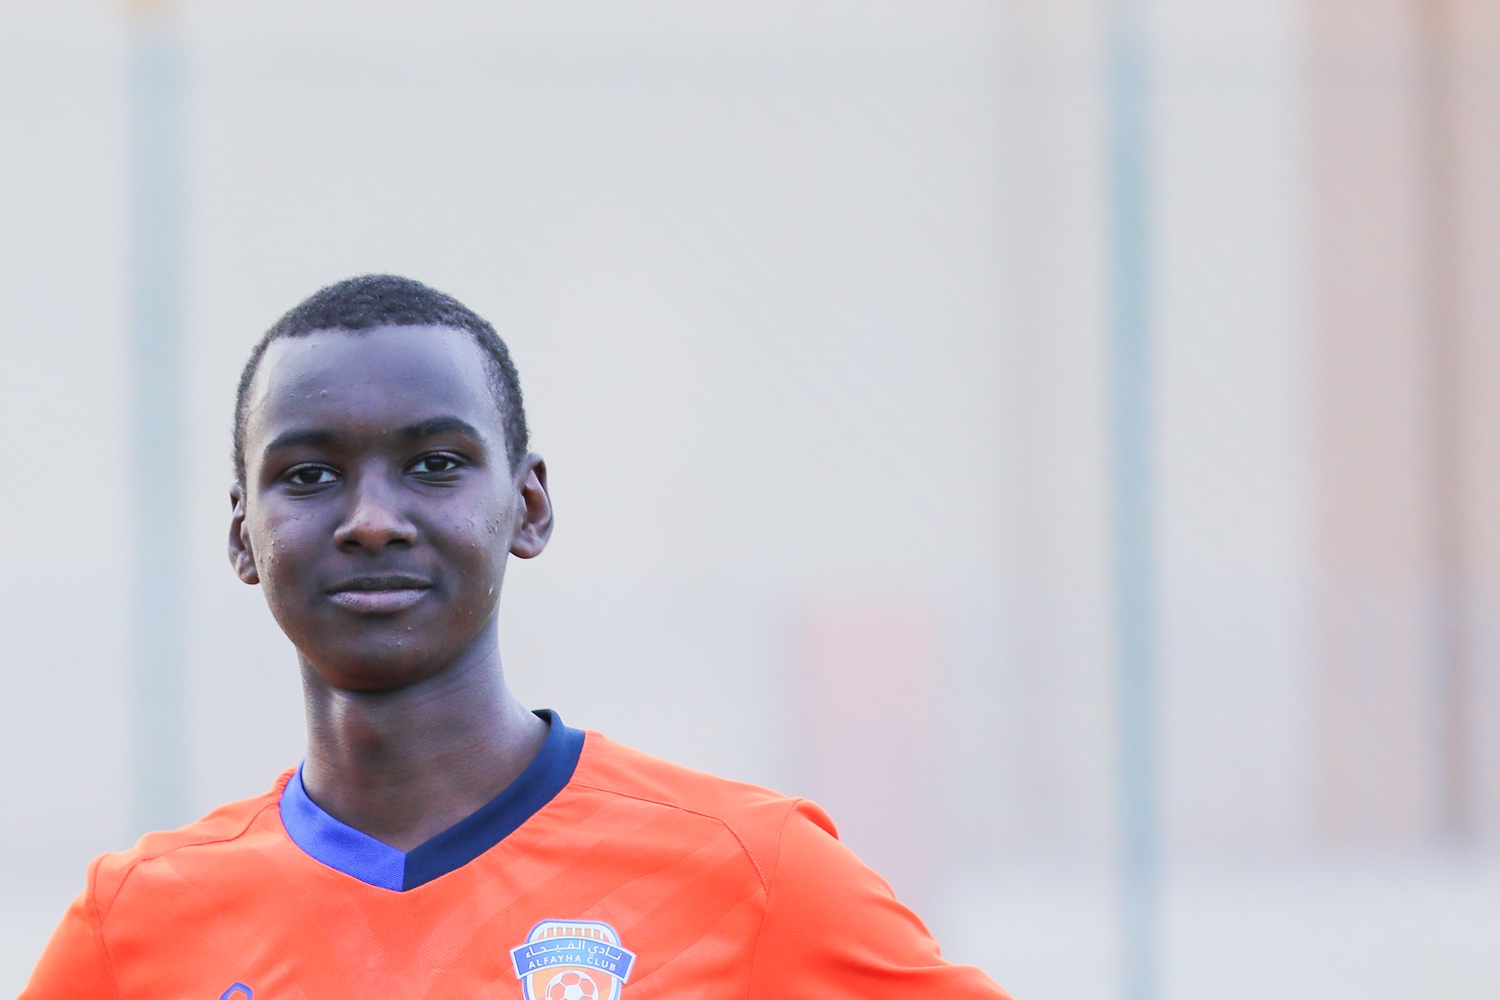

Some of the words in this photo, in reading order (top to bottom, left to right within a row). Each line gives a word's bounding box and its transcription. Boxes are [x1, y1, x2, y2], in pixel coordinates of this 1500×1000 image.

[526, 940, 585, 958] الفيحاء
[588, 946, 622, 960] نادي
[529, 955, 581, 969] ALFAYHA
[587, 956, 616, 971] CLUB
